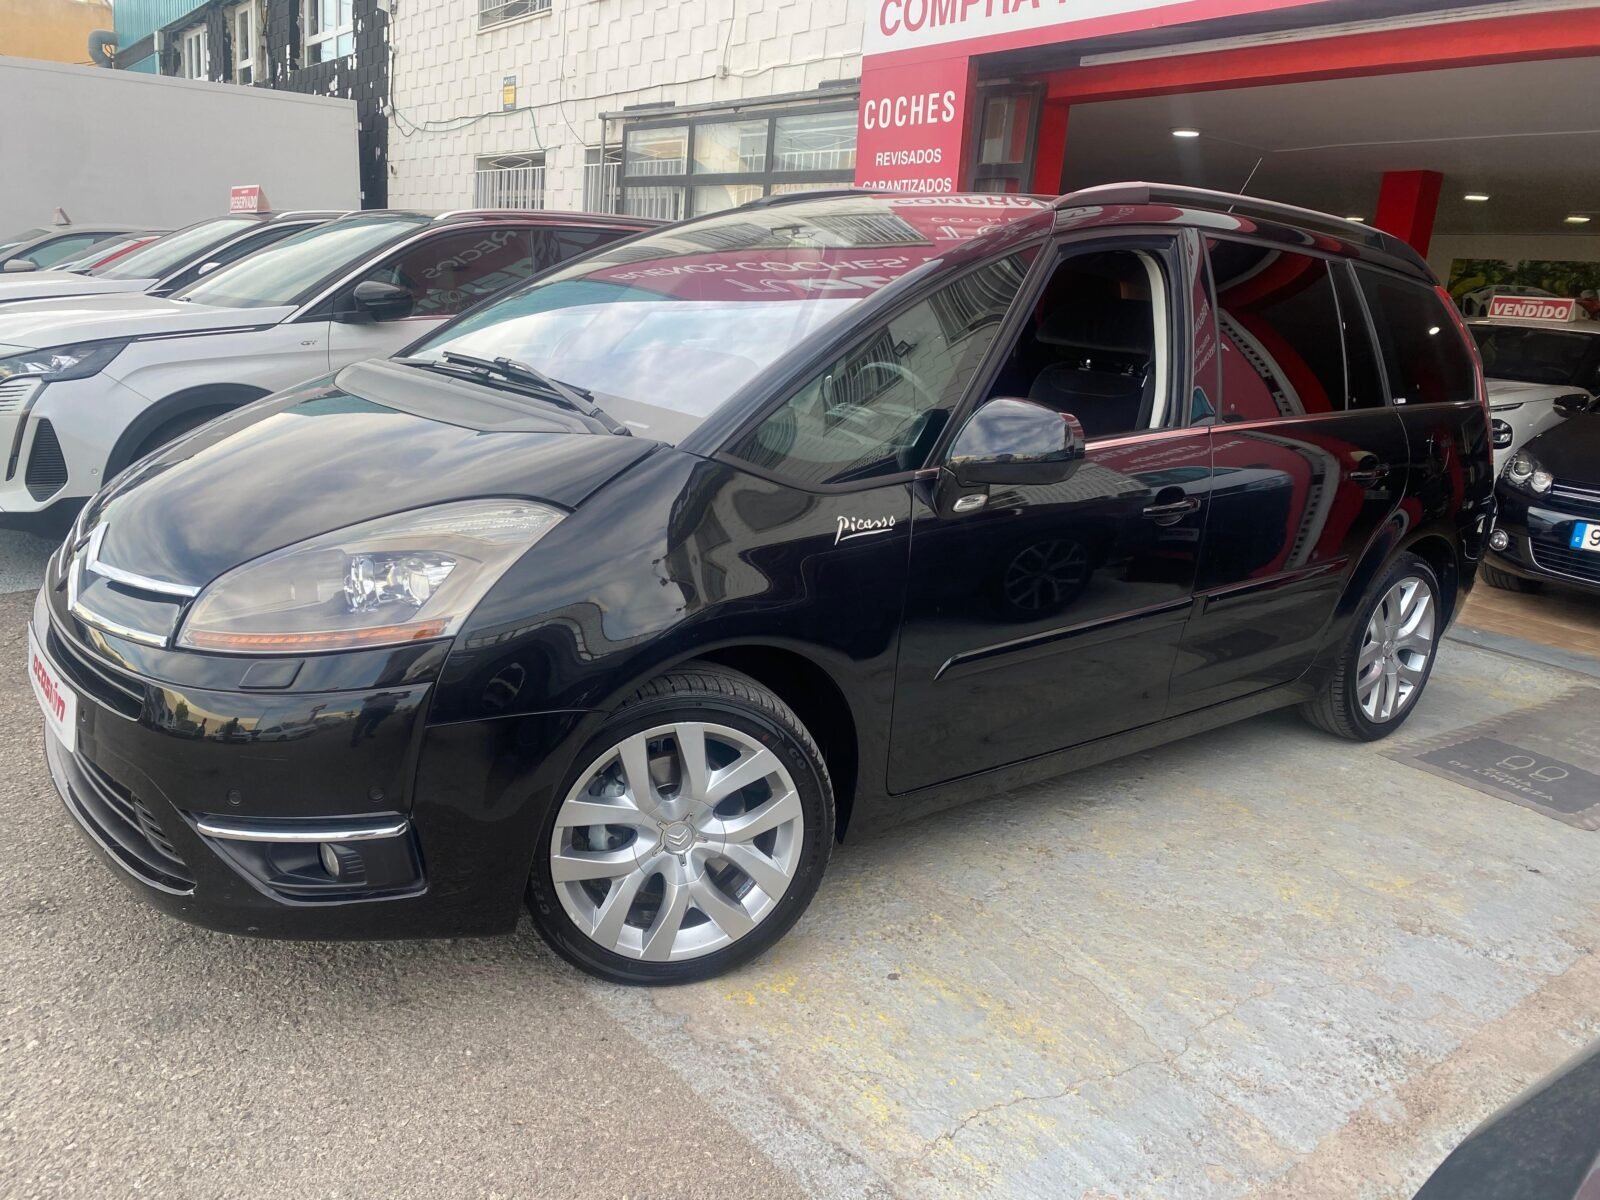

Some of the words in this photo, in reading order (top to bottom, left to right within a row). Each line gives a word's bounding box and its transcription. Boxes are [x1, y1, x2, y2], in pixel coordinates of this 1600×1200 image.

[880, 0, 1040, 37] COMP
[863, 90, 956, 130] COCHES
[875, 148, 942, 167] REVISADOS
[1493, 303, 1568, 319] VENDIDO
[834, 515, 896, 546] Picasso
[1473, 768, 1553, 801] LIMPIEZA
